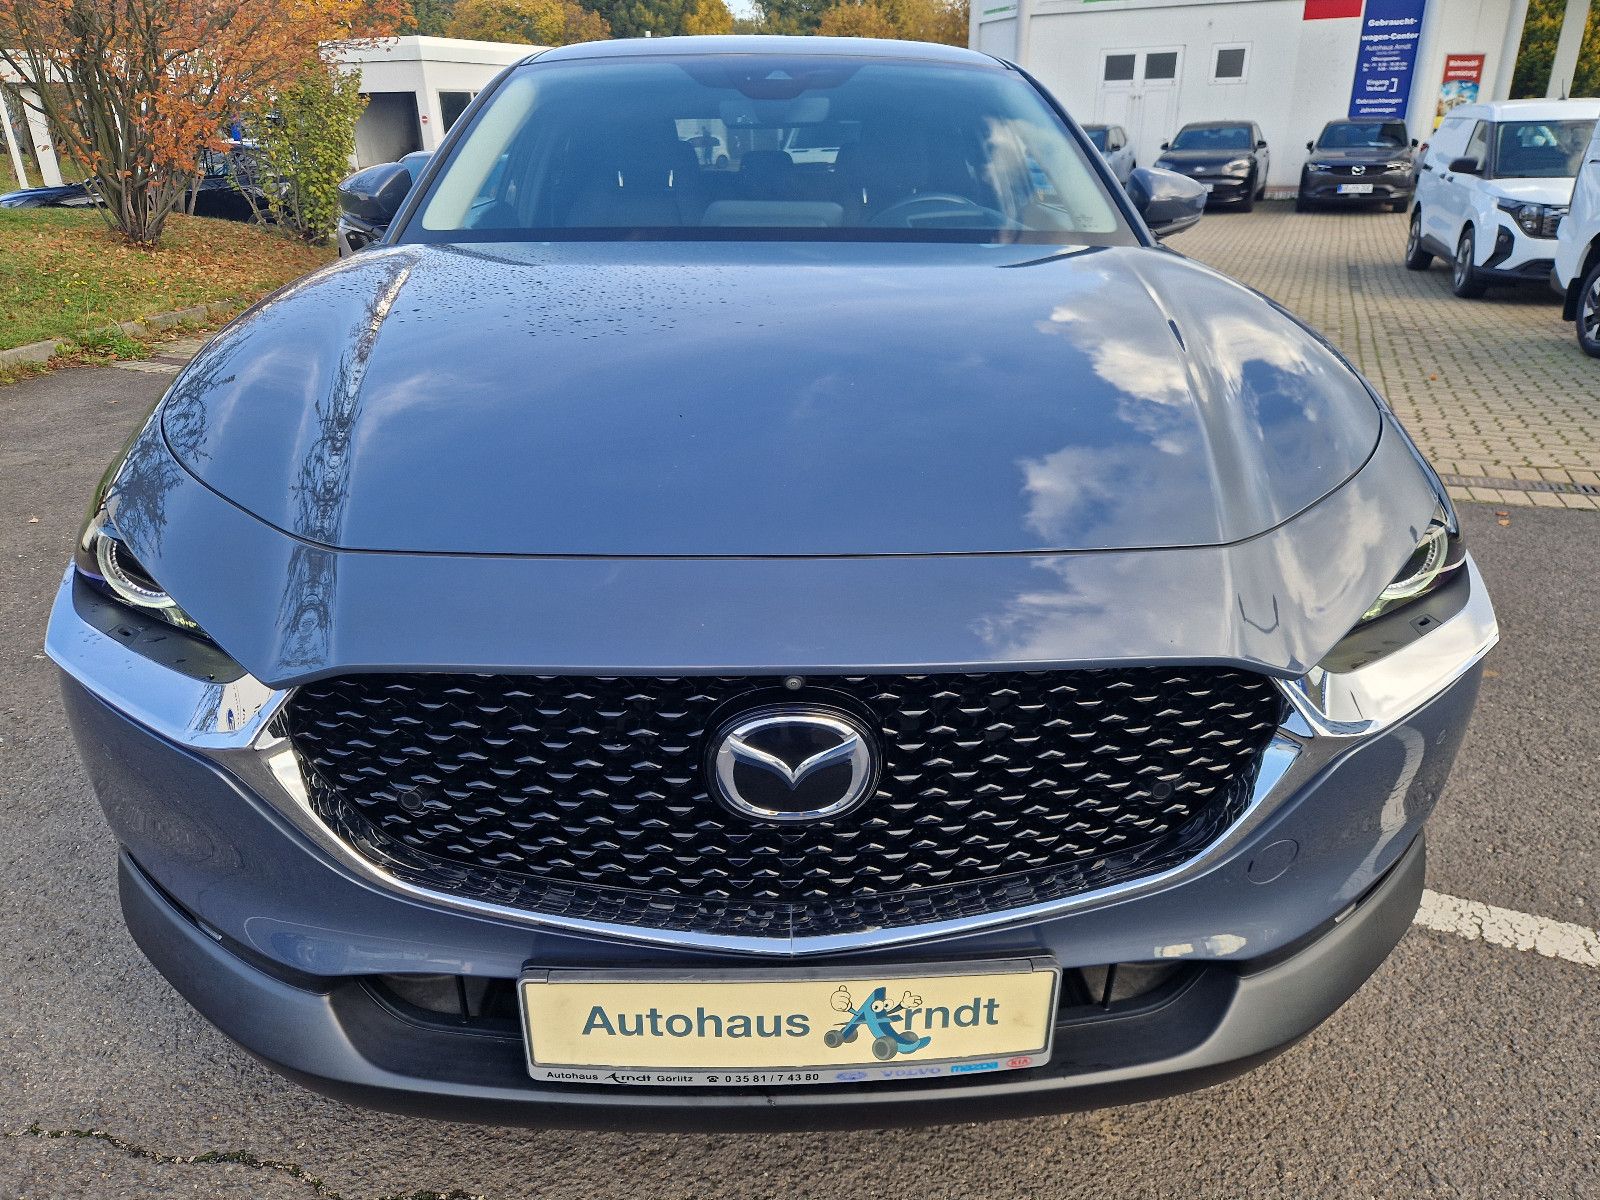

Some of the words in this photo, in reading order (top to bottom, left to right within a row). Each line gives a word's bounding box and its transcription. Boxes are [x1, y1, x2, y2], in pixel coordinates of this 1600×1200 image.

[1368, 18, 1418, 27] Gebraucht-
[1361, 33, 1420, 42] wagen-Center
[581, 1005, 811, 1038] Autohaus
[881, 1067, 941, 1077] VOLVO
[950, 1061, 999, 1073] mazda
[546, 1071, 599, 1081] Autohaus
[604, 1072, 651, 1084] Arndt
[656, 1075, 694, 1083] Görlitz
